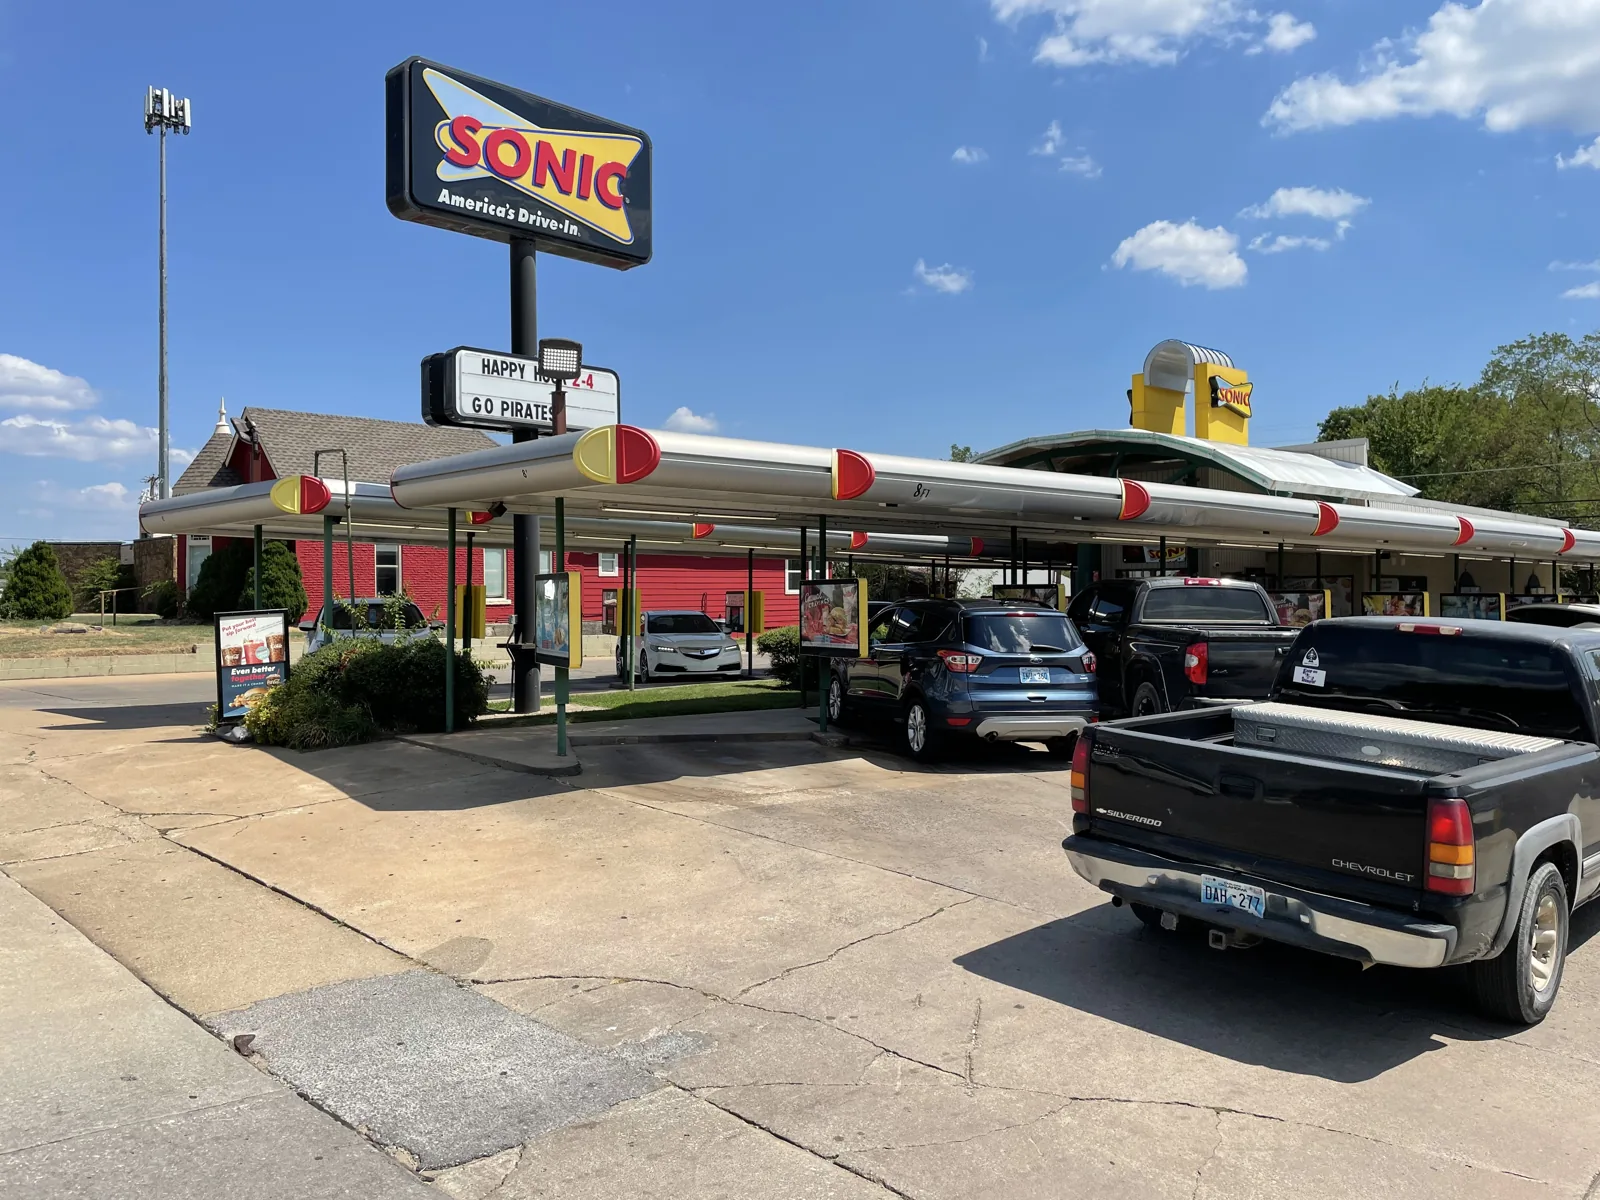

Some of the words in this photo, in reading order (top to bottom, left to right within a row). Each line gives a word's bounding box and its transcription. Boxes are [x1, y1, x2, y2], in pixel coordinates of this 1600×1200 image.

[446, 114, 627, 209] SONIC
[438, 188, 515, 219] America's
[481, 358, 525, 379] HAPPY
[572, 373, 594, 389] 2-4
[472, 397, 494, 414] GO
[1219, 387, 1249, 406] SONIC
[1148, 547, 1185, 559] SON
[235, 622, 257, 634] forward
[231, 674, 266, 682] together
[251, 666, 275, 674] better
[1106, 809, 1162, 827] SILVERADO
[1332, 858, 1415, 882] CHEVROLET
